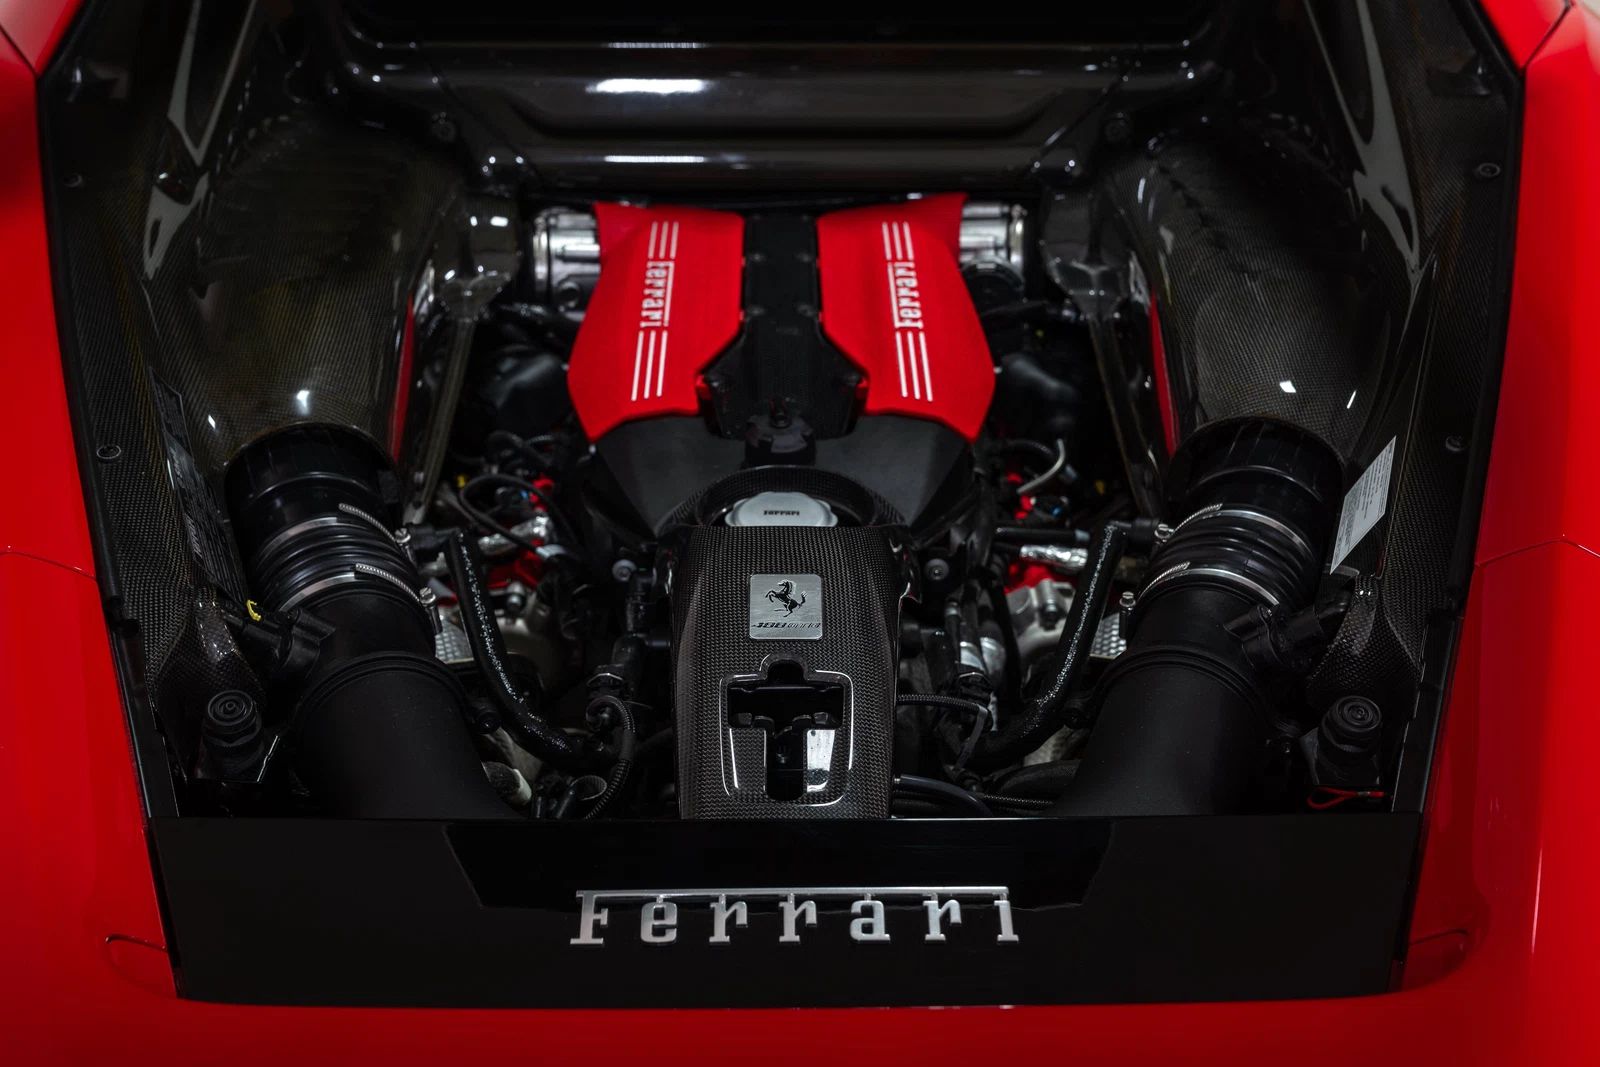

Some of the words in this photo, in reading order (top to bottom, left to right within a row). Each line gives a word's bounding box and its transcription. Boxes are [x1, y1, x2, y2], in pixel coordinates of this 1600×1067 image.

[639, 260, 675, 328] Ferrari
[887, 261, 924, 330] Ferrari
[570, 886, 1020, 946] Ferrari
